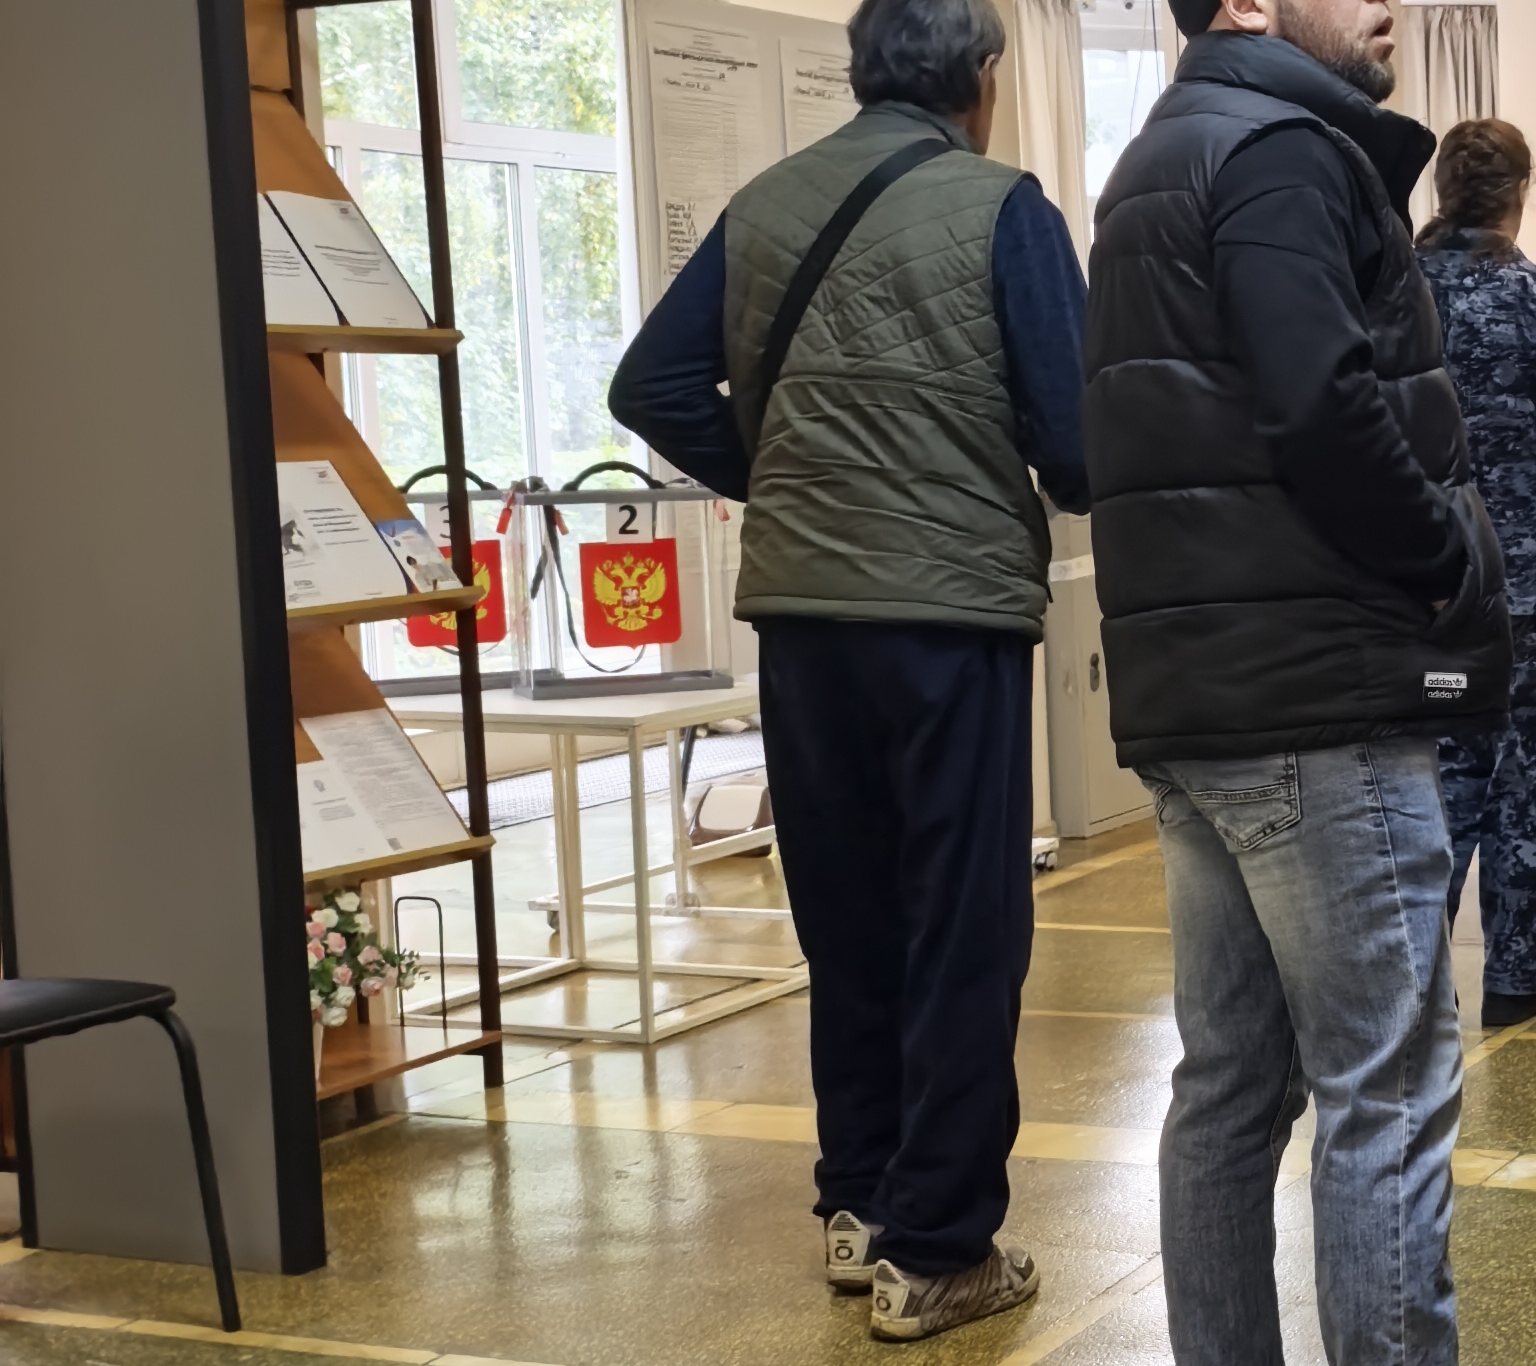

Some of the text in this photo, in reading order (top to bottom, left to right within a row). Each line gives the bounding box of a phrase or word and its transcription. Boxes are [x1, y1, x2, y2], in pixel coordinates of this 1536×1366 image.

[618, 504, 639, 535] 2
[1428, 677, 1453, 686] adidas
[1427, 689, 1453, 698] adidas
